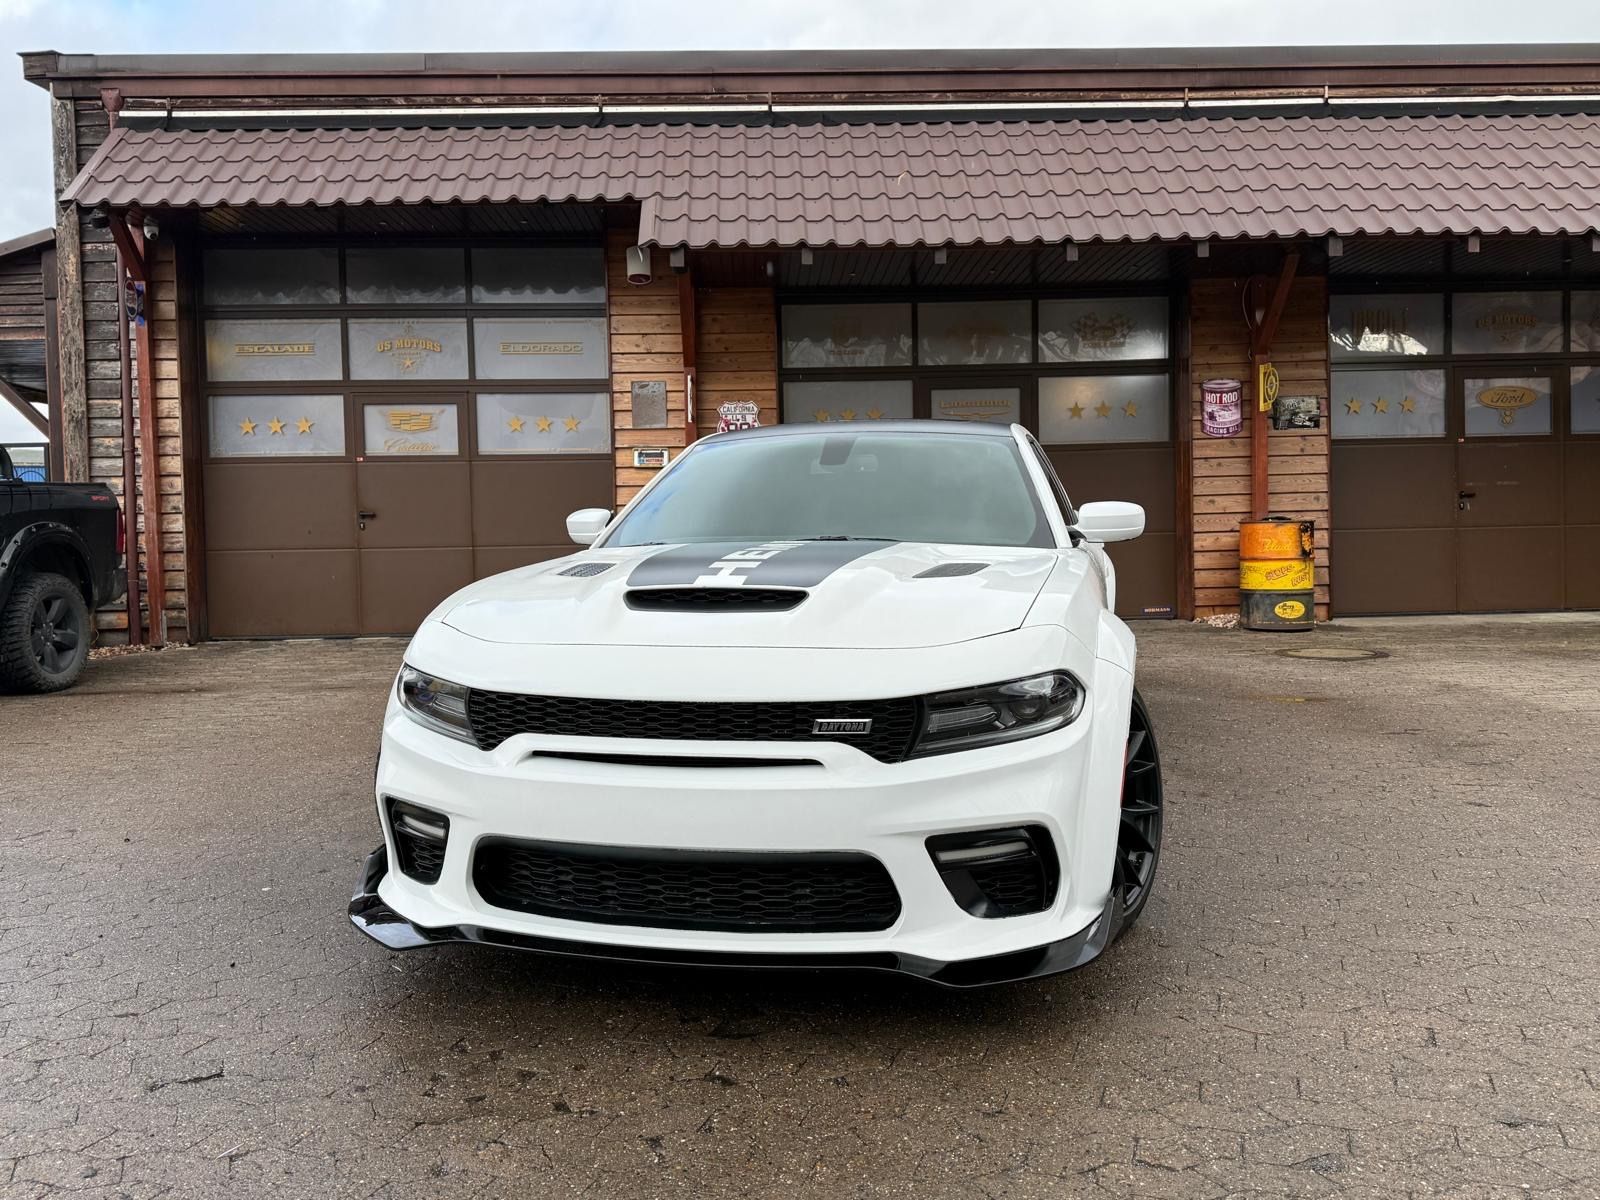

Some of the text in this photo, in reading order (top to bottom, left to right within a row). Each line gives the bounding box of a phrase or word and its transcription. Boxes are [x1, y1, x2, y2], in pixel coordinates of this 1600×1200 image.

[235, 344, 315, 354] ESCALADE
[376, 338, 442, 353] US MOTORS
[500, 343, 583, 353] ELDORADO
[1206, 391, 1238, 404] HOT ROD
[722, 405, 755, 413] CALIFORNIA
[820, 722, 865, 732] DAYTONA
